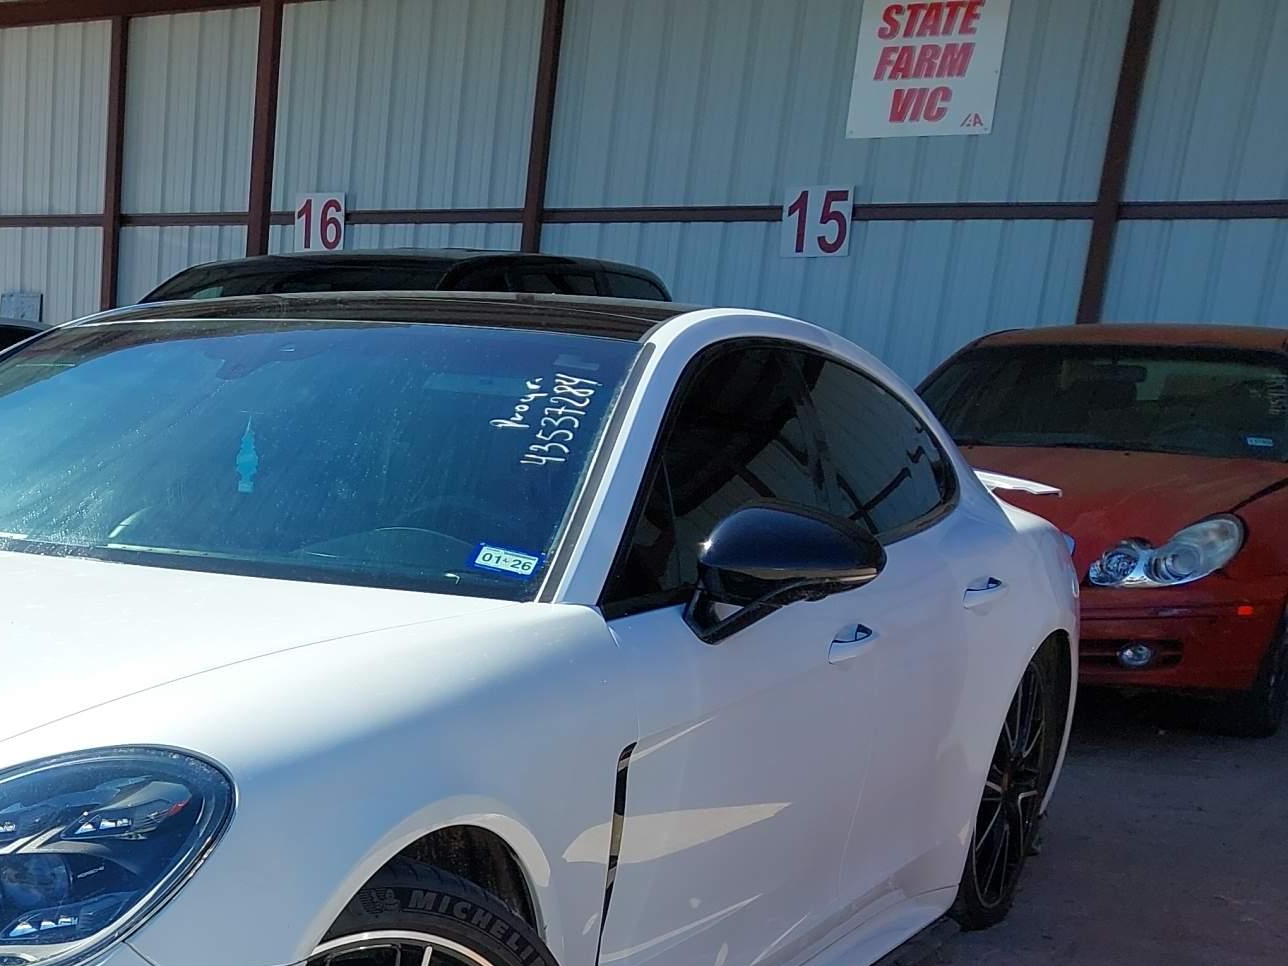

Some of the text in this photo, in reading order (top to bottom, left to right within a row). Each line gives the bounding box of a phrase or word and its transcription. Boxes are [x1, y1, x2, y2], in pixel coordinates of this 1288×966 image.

[877, 0, 985, 41] STATE
[872, 42, 977, 82] FARM
[888, 86, 953, 124] VIC
[297, 198, 342, 250] 16
[787, 190, 849, 254] 15
[519, 373, 603, 466] 43537284
